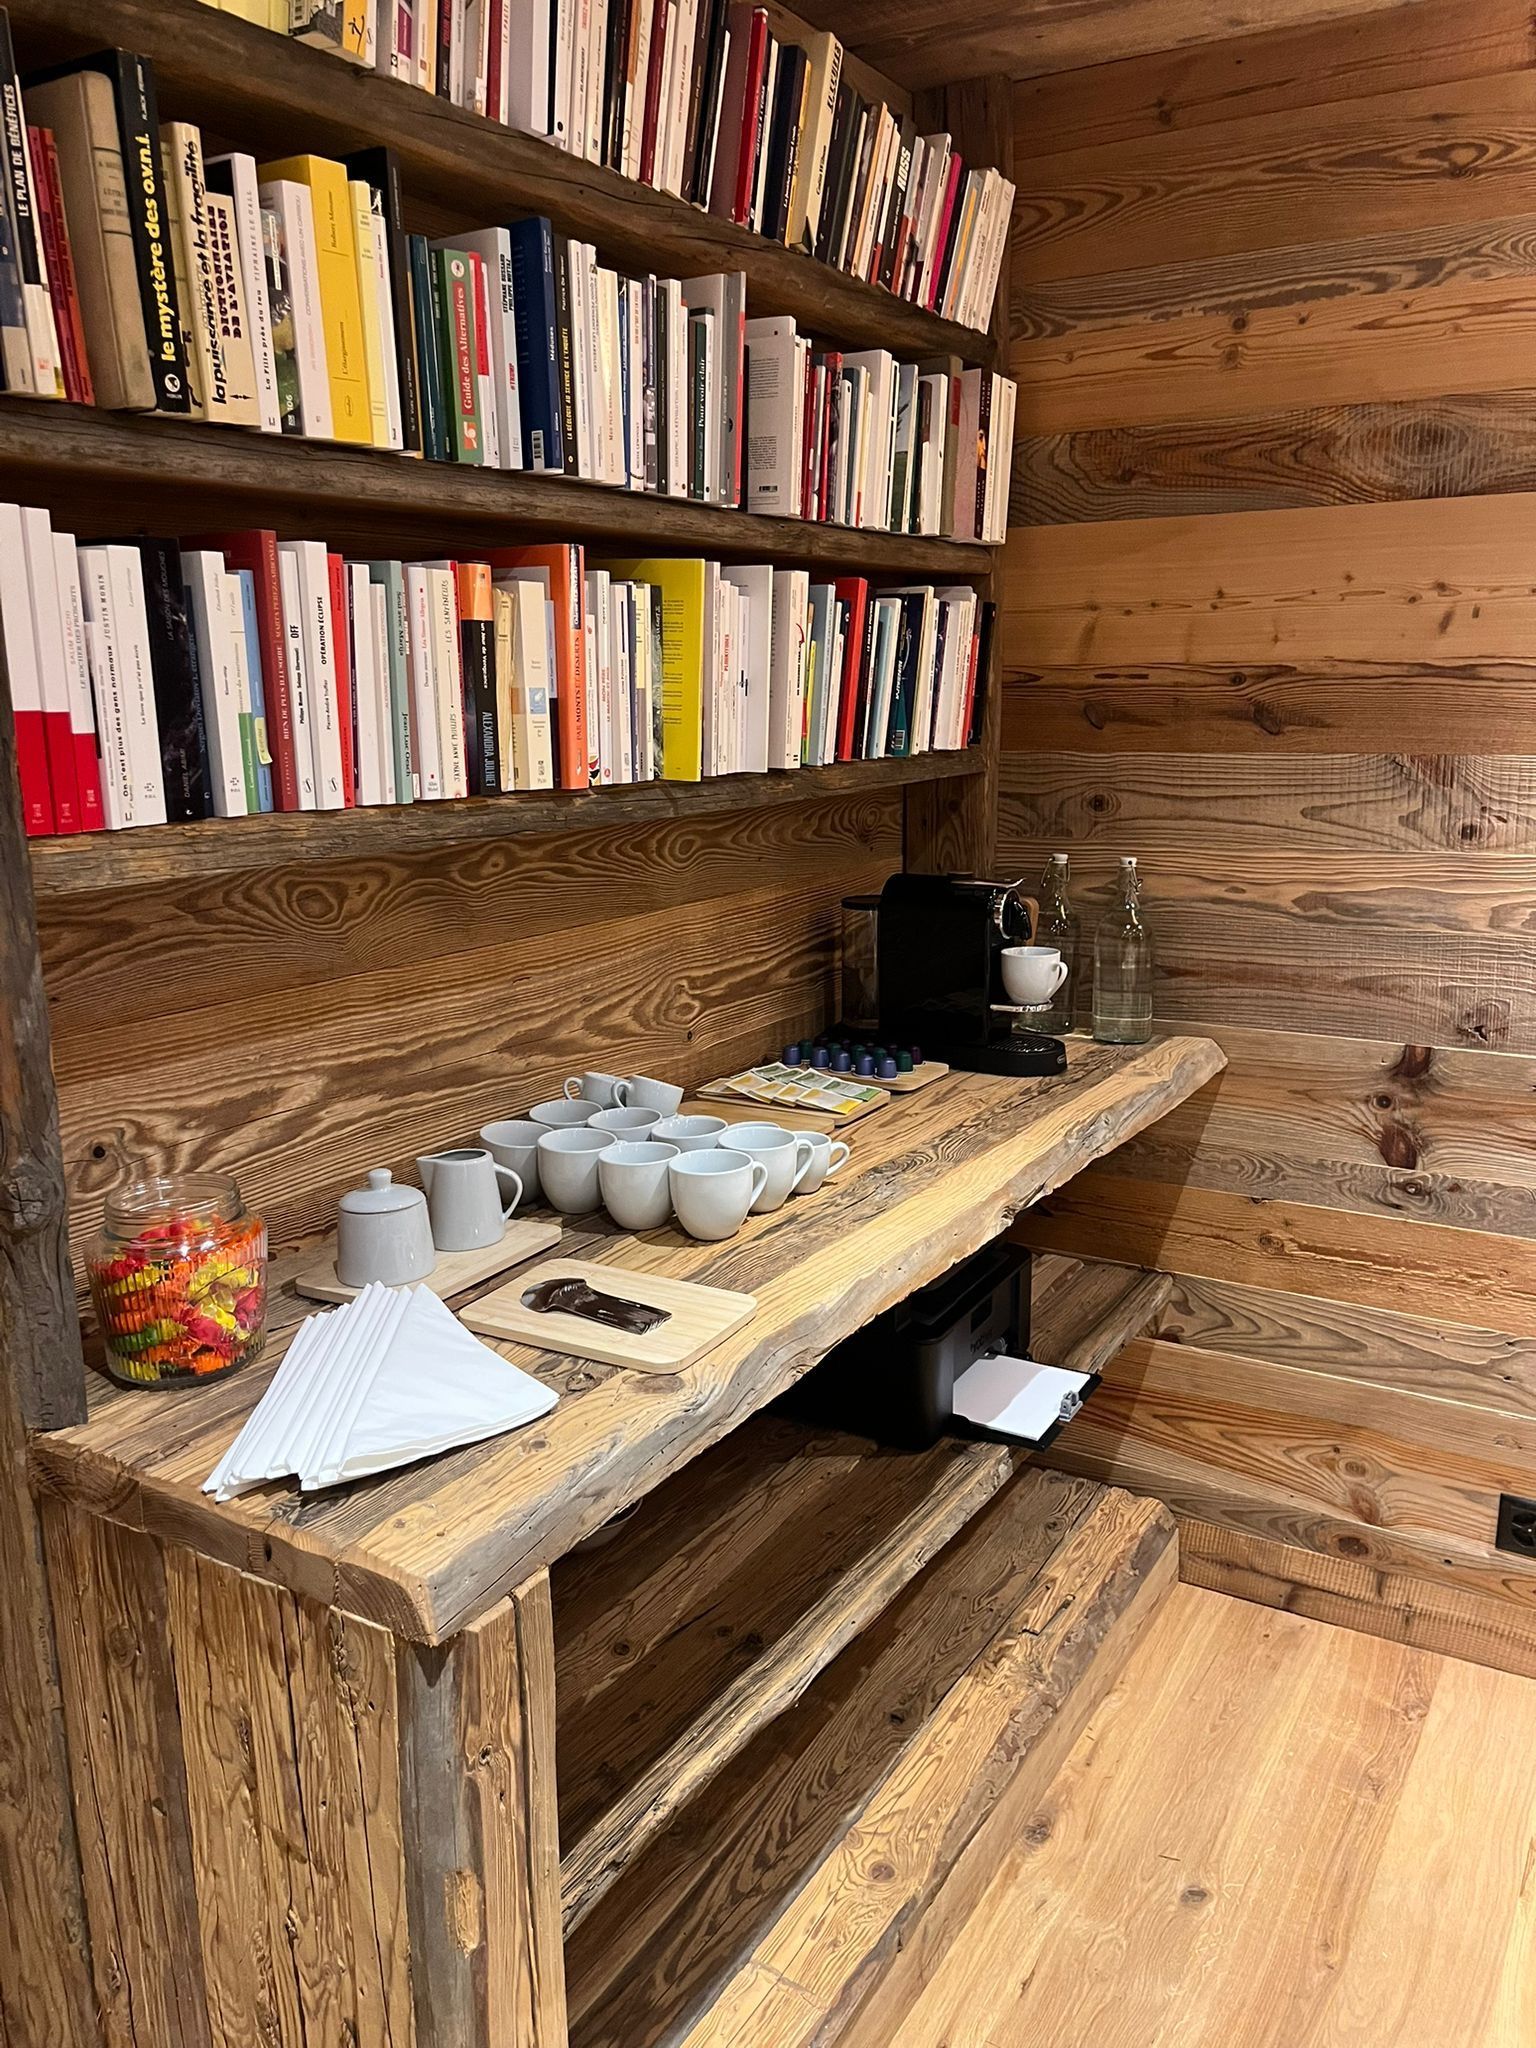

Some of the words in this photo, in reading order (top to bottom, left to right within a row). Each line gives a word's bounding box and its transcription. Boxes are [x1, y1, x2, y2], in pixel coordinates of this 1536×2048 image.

[4, 84, 21, 147] BÉNÉFICES
[11, 151, 23, 166] DE
[897, 146, 911, 191] ROSS
[14, 170, 27, 201] PLAN
[184, 141, 205, 225] fragilité
[18, 204, 29, 216] LE
[145, 198, 160, 238] des
[249, 220, 256, 231] LE
[193, 229, 207, 249] la
[197, 252, 211, 275] et
[207, 206, 230, 336] DICTIONNAIRE
[217, 208, 238, 310] L'AVIATION
[150, 243, 174, 338] mystère
[231, 316, 242, 339] DE
[258, 310, 264, 322] du
[457, 288, 468, 353] Alternatives
[203, 278, 226, 383] puissance
[260, 326, 268, 348] près
[161, 341, 176, 361] le
[461, 356, 470, 374] des
[564, 361, 570, 369] DE
[212, 385, 227, 404] la
[266, 378, 271, 390] La
[462, 376, 472, 409] Guide
[565, 395, 571, 404] AU
[98, 575, 106, 603] MORIN
[162, 589, 170, 602] DES
[70, 585, 80, 628] PROSCRITS
[164, 603, 173, 629] SAISON
[101, 607, 111, 639] JUSTIN
[289, 625, 299, 639] OFF
[167, 631, 174, 641] LA
[319, 625, 327, 665] OPÉRATION
[68, 640, 76, 665] SALIM
[77, 646, 85, 678] ROCHER
[107, 645, 116, 688] normaux
[80, 680, 86, 689] LE
[113, 691, 121, 714] gens
[193, 682, 203, 722] Dovlatov
[141, 717, 146, 725] Le
[282, 710, 288, 719] DE
[482, 712, 494, 757] ALEXANDRA
[119, 759, 127, 781] n'est
[484, 758, 496, 786] JULHIET
[123, 784, 129, 797] On
[182, 772, 190, 798] DANIEL
